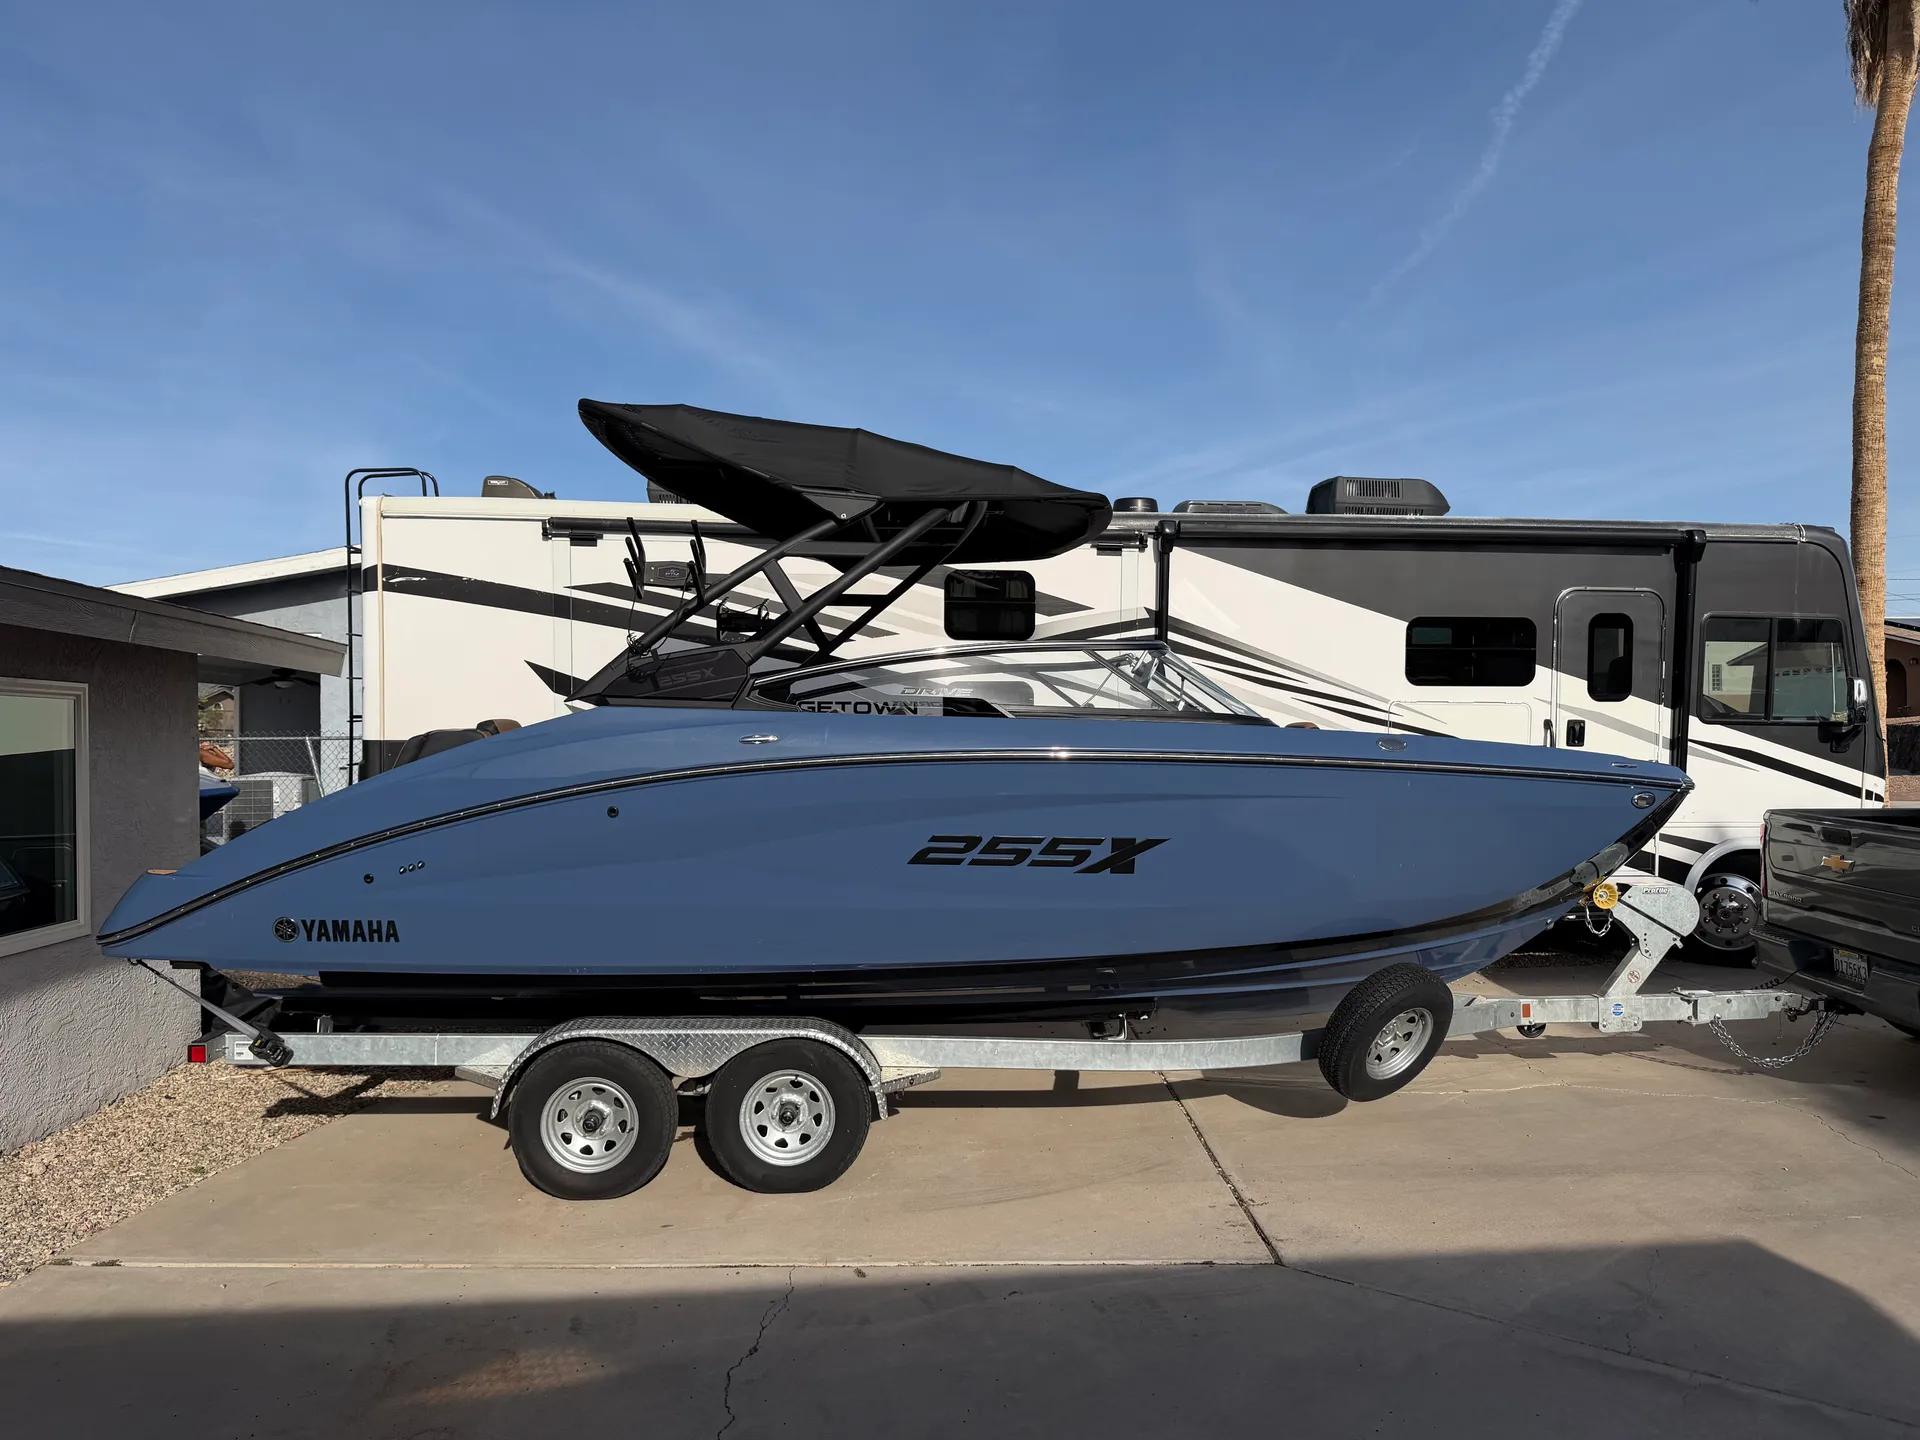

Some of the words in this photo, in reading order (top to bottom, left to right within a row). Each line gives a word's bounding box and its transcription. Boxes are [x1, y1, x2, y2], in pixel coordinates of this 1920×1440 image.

[900, 687, 974, 697] DRIVE
[907, 834, 1172, 875] 255X
[300, 919, 400, 942] YAMAHA
